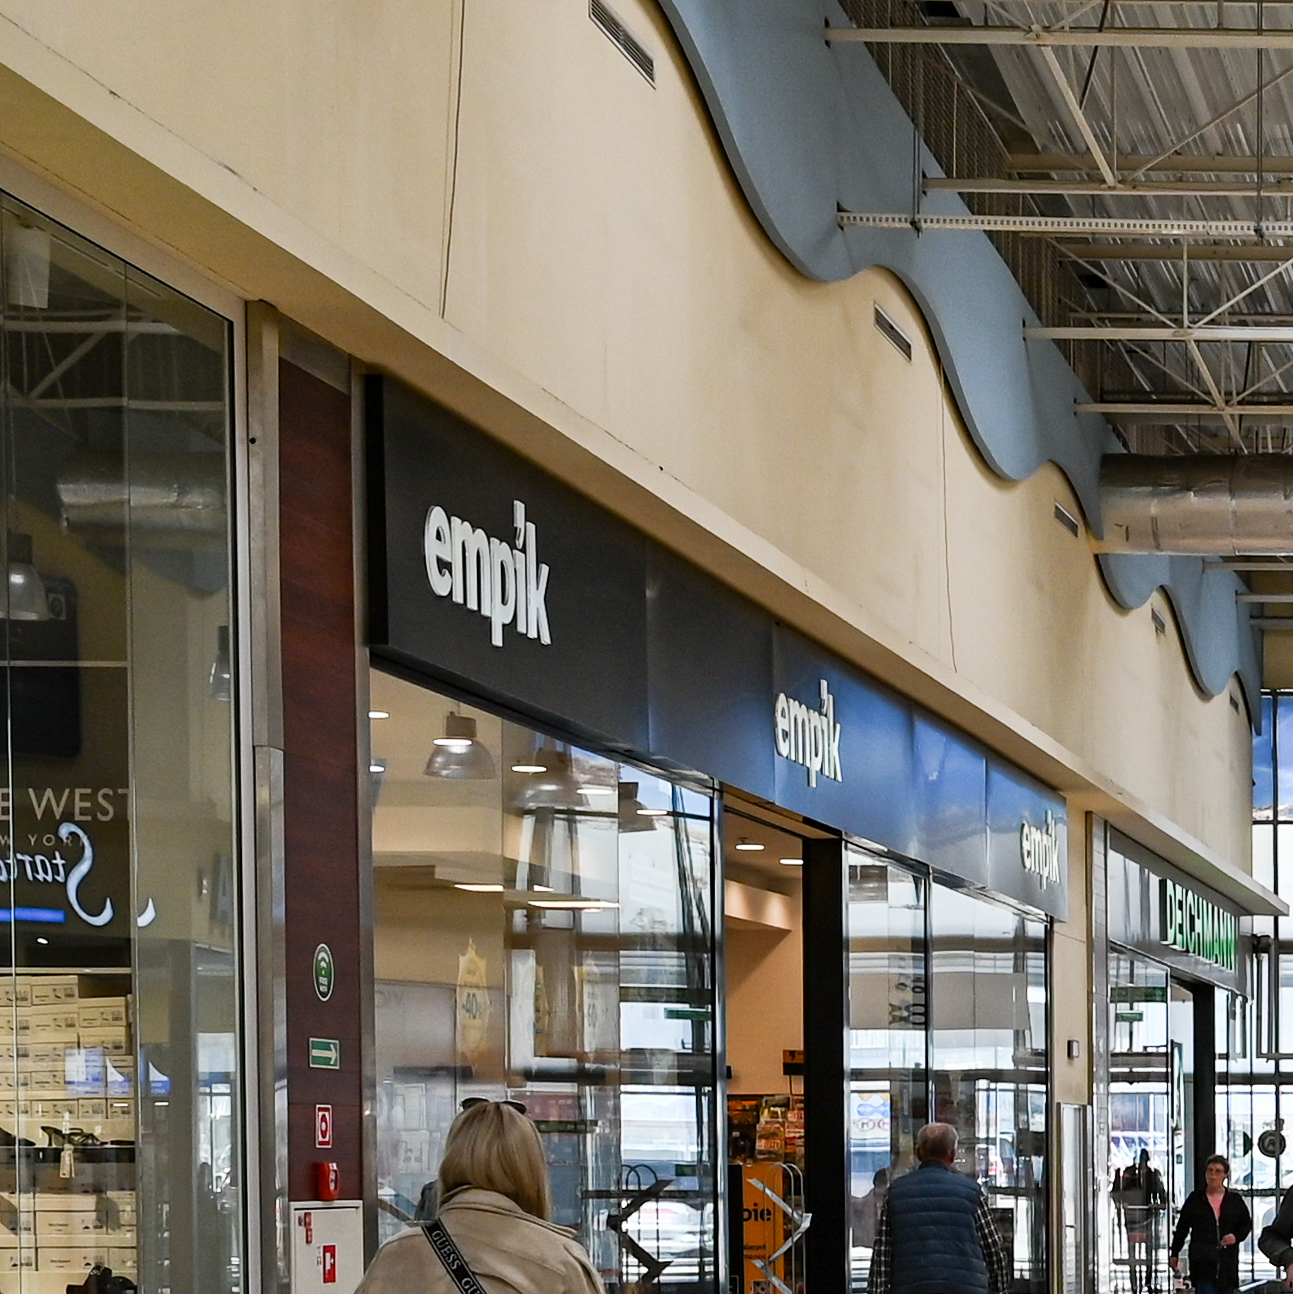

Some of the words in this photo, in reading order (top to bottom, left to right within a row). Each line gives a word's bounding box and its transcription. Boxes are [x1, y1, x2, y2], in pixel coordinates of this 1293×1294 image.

[423, 500, 552, 648] empik
[773, 678, 842, 788] empik
[1019, 808, 1061, 891] empik
[1163, 878, 1238, 972] DEICHMANN
[431, 1230, 462, 1271] GUESS
